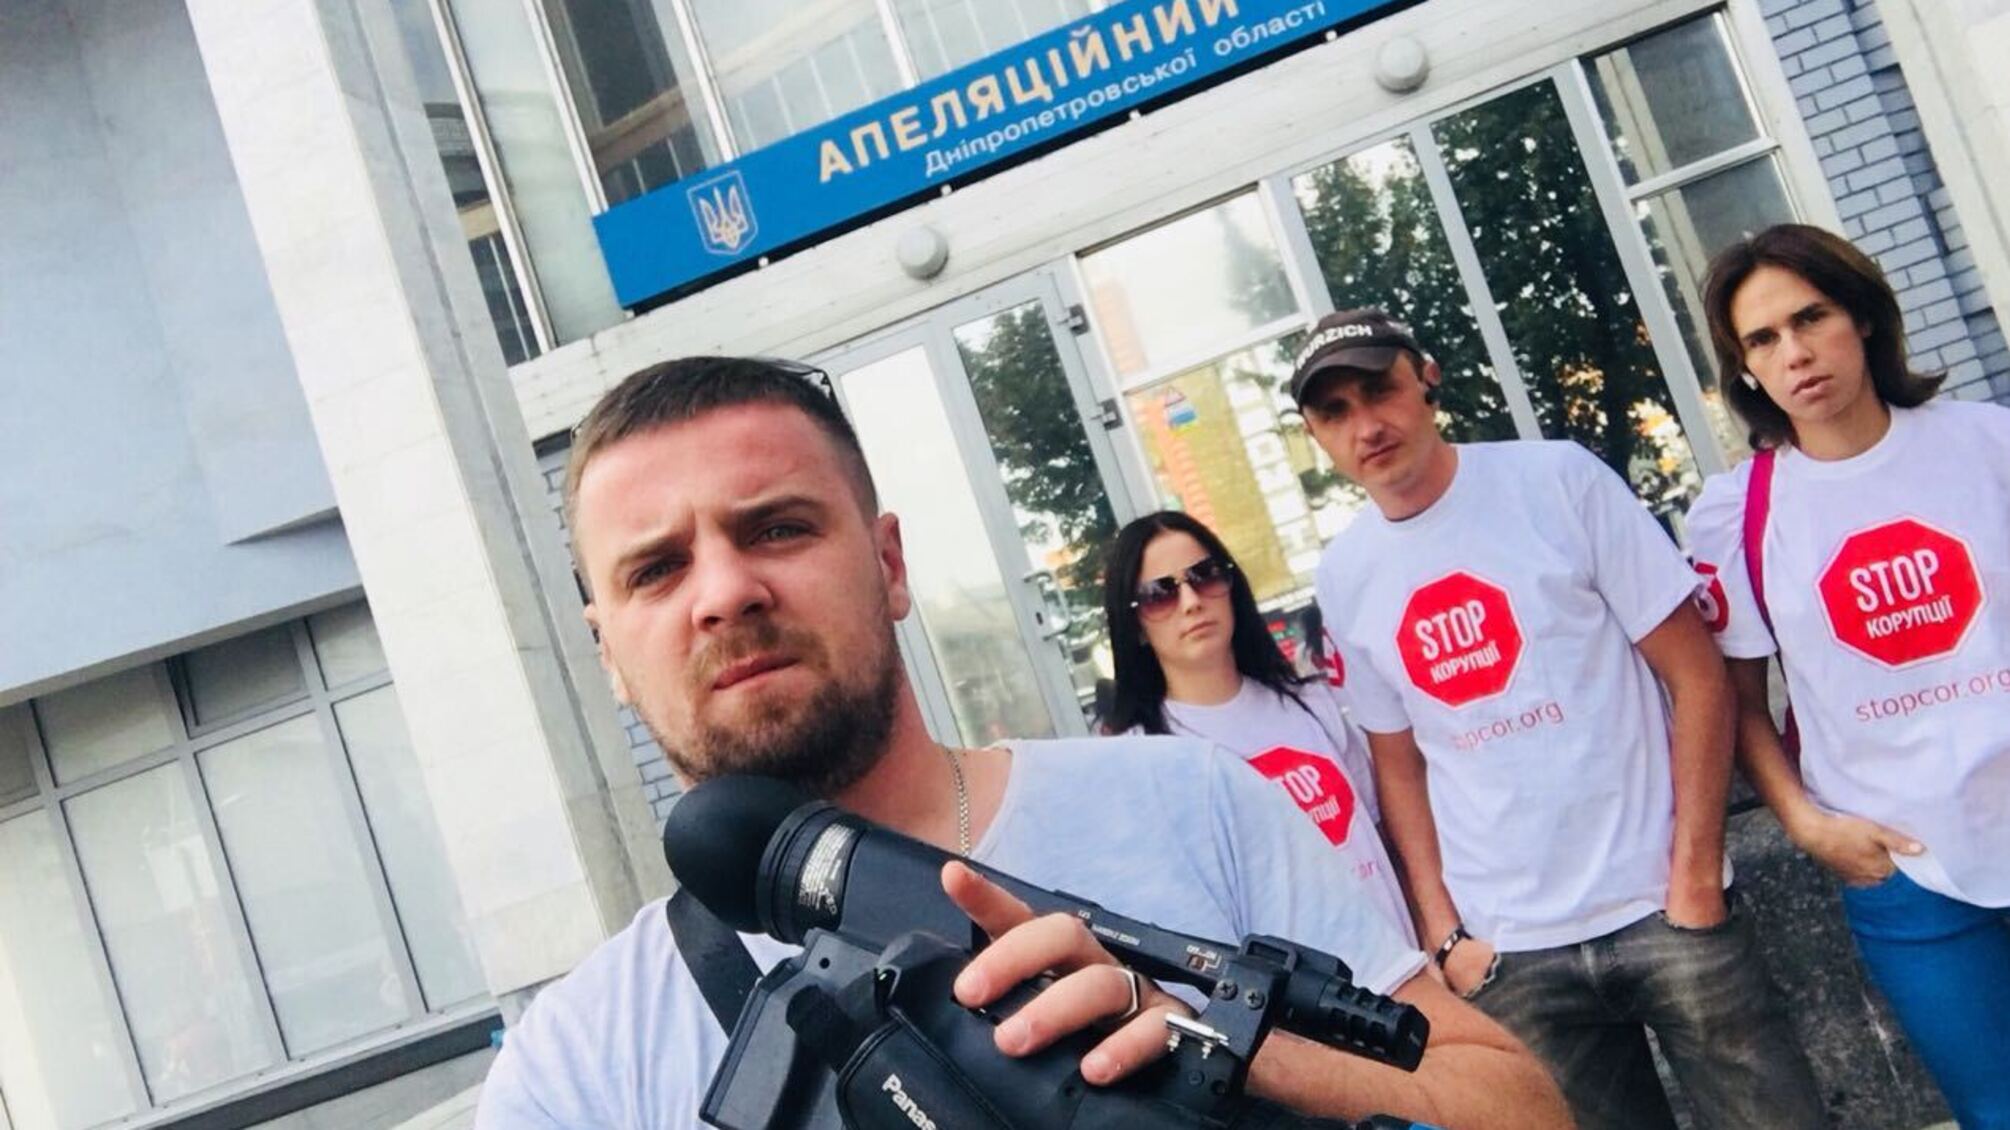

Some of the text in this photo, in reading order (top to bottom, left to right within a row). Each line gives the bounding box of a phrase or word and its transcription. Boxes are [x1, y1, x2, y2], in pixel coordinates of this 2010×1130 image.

[925, 0, 1326, 178] Дніпропетровської області
[1849, 549, 1940, 613] STOP
[1415, 599, 1486, 660] STOP
[1865, 594, 1954, 640] КОРУПЦІЇ
[1430, 639, 1502, 684] КОРУПЦІЇ
[1855, 668, 2010, 724] stopcor.org
[1454, 701, 1564, 750] pcor.org
